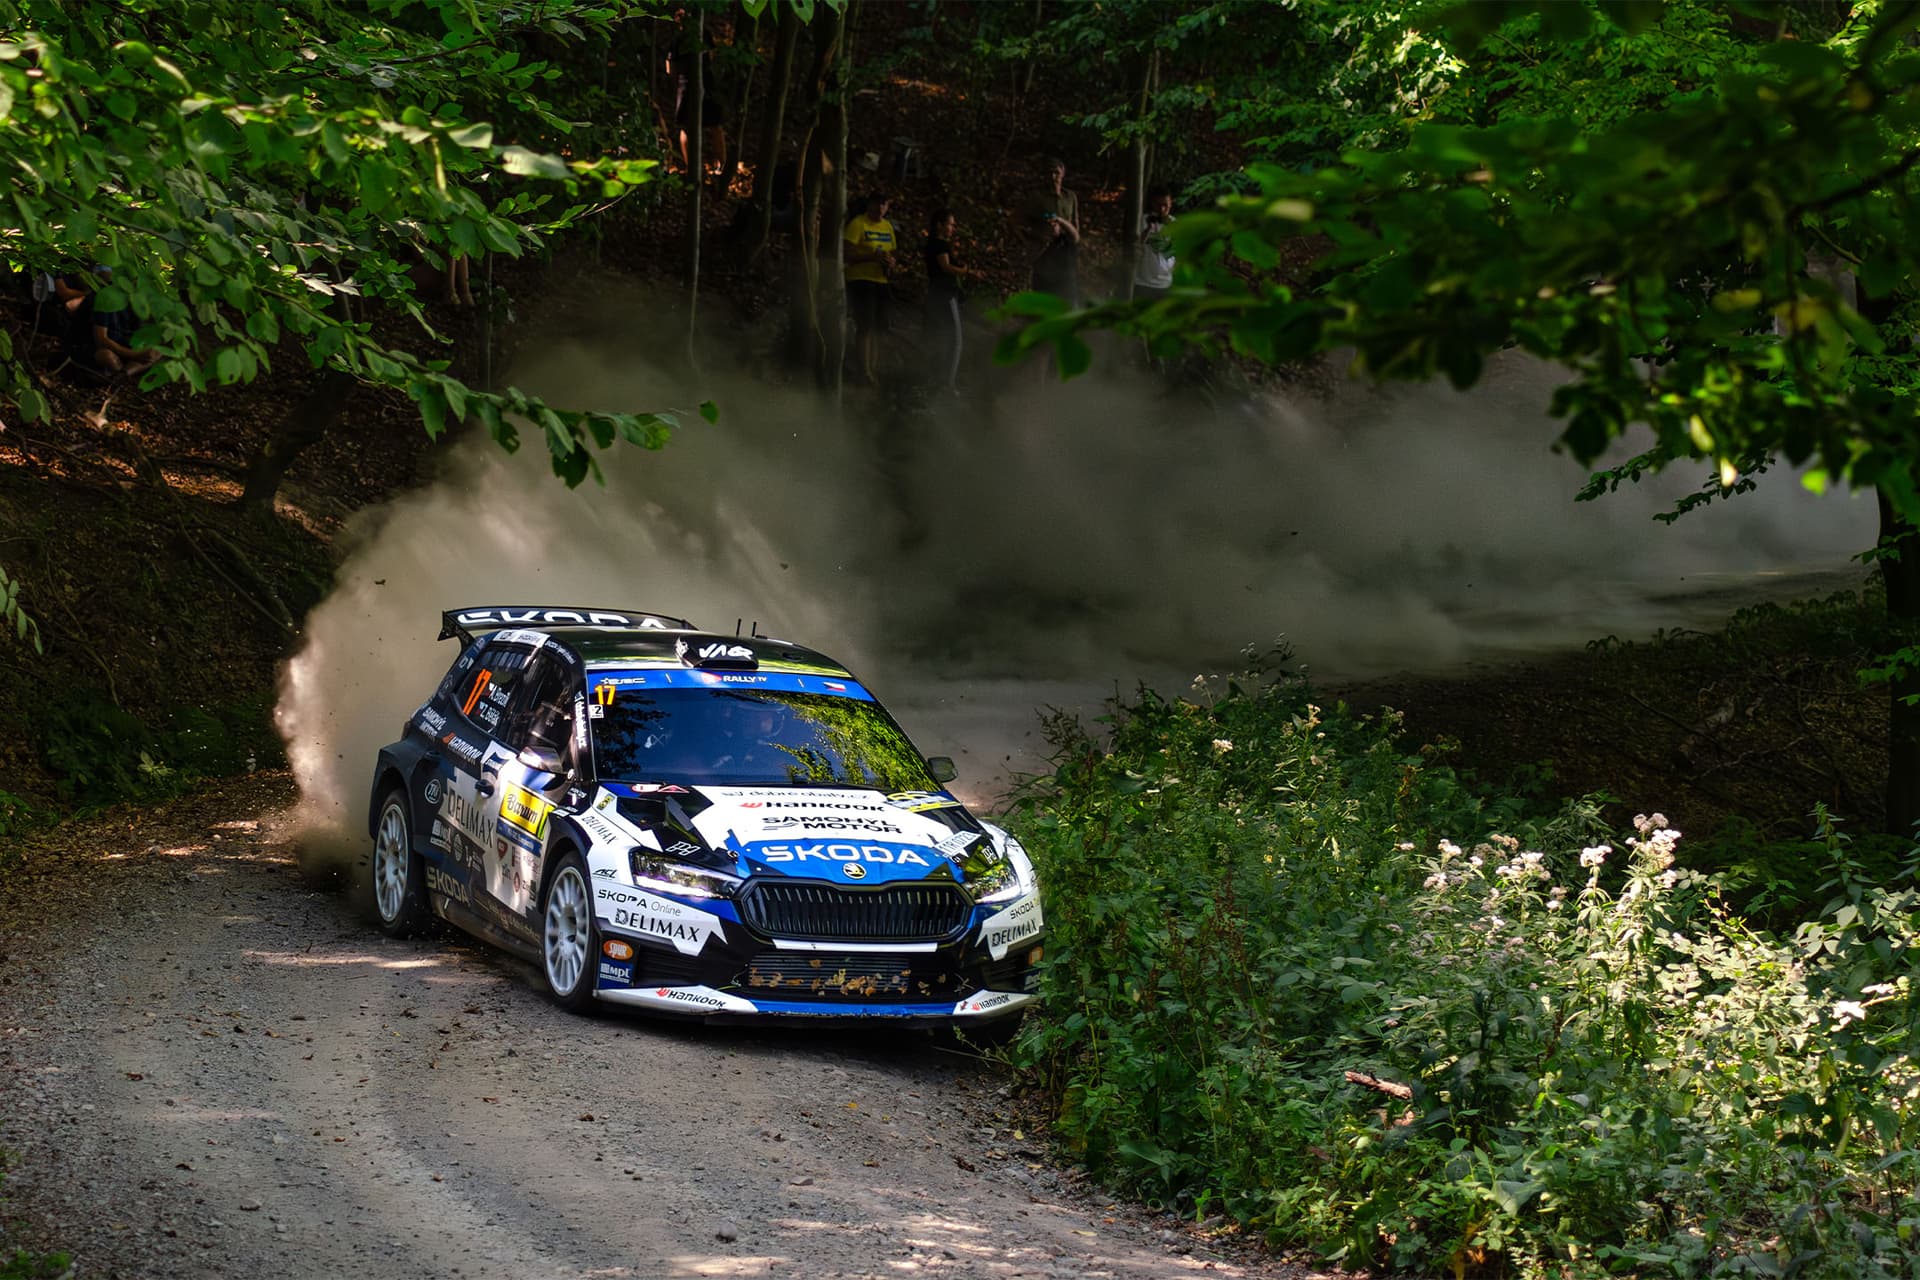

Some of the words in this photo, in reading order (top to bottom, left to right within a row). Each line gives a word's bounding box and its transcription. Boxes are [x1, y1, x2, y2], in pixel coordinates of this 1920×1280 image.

[723, 675, 757, 683] RALLY
[595, 686, 617, 705] 17
[447, 788, 494, 849] DELIMAX
[507, 793, 538, 825] Barum
[581, 815, 618, 845] DELIMAX
[803, 822, 903, 834] MOTOR
[651, 902, 682, 917] Online
[616, 908, 701, 943] DELIMAX
[991, 918, 1037, 948] DELIMAX
